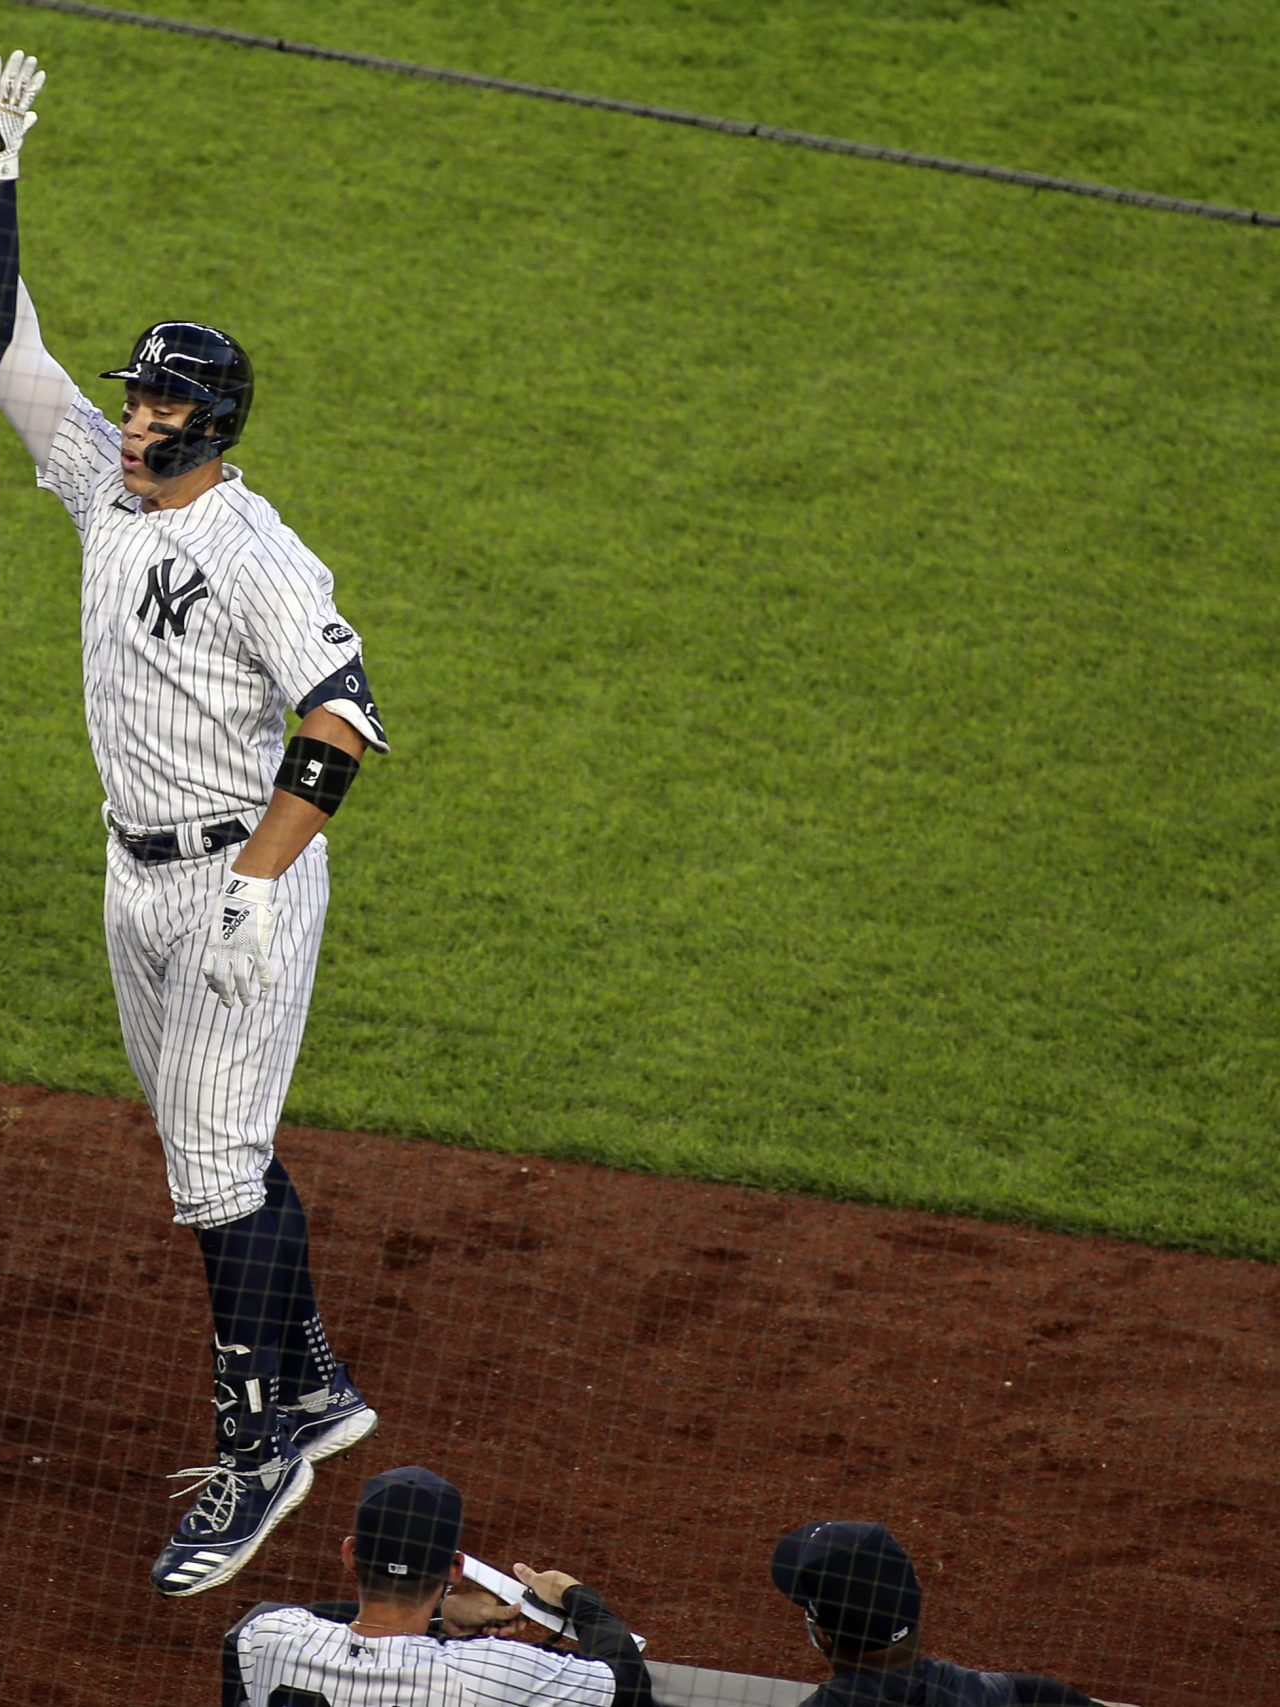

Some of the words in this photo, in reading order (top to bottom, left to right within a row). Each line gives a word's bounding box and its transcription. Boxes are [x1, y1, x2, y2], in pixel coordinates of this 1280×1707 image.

[140, 335, 166, 364] NY
[136, 558, 209, 641] NY
[222, 908, 251, 941] adidas
